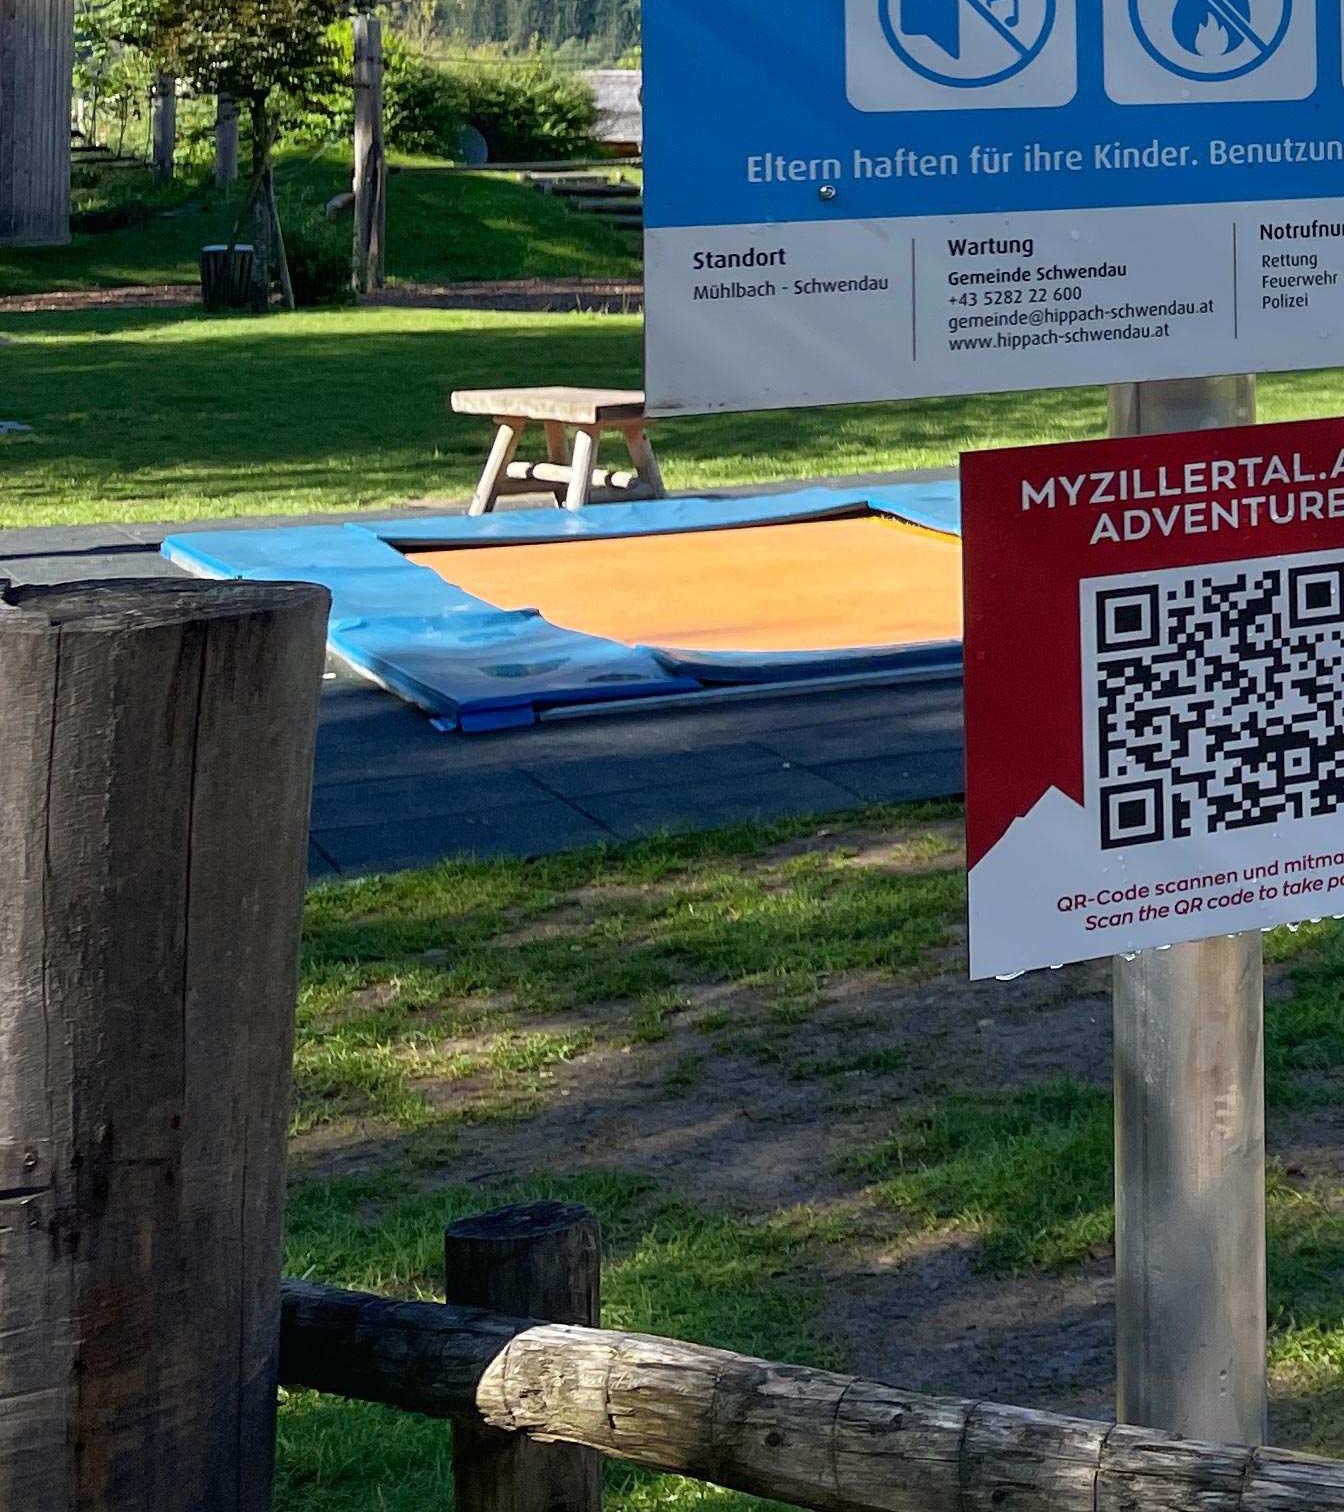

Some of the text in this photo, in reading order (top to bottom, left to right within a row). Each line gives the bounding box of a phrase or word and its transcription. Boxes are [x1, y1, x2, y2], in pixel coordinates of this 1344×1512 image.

[747, 153, 842, 184] Eltern
[853, 148, 959, 178] haften
[969, 145, 1014, 175] für
[1023, 142, 1083, 172] ihre
[1094, 139, 1199, 170] Kinder.
[693, 248, 787, 270] Standort
[947, 238, 1034, 257] Wartung
[1262, 254, 1318, 269] Rettung
[948, 262, 1127, 286] Gemeinde Schwendau
[1262, 270, 1338, 288] Feuerwehr
[693, 280, 776, 301] Mühlbach
[793, 275, 889, 295] Schwendau
[948, 286, 1082, 307] +43 5282 22 600
[1262, 292, 1309, 309] Polizei
[948, 299, 1214, 333] gemeinde@hippach-schwendau.at
[949, 323, 1170, 351] www.hippach-schwendau.at
[1056, 883, 1150, 913] QR-Code
[1154, 869, 1238, 896] scannen
[1243, 860, 1279, 882] und
[1085, 912, 1133, 931] Scan
[1138, 903, 1170, 922] the
[1174, 897, 1203, 916] QR
[1207, 888, 1254, 910] code
[1258, 883, 1278, 901] to
[1282, 875, 1324, 898] take
